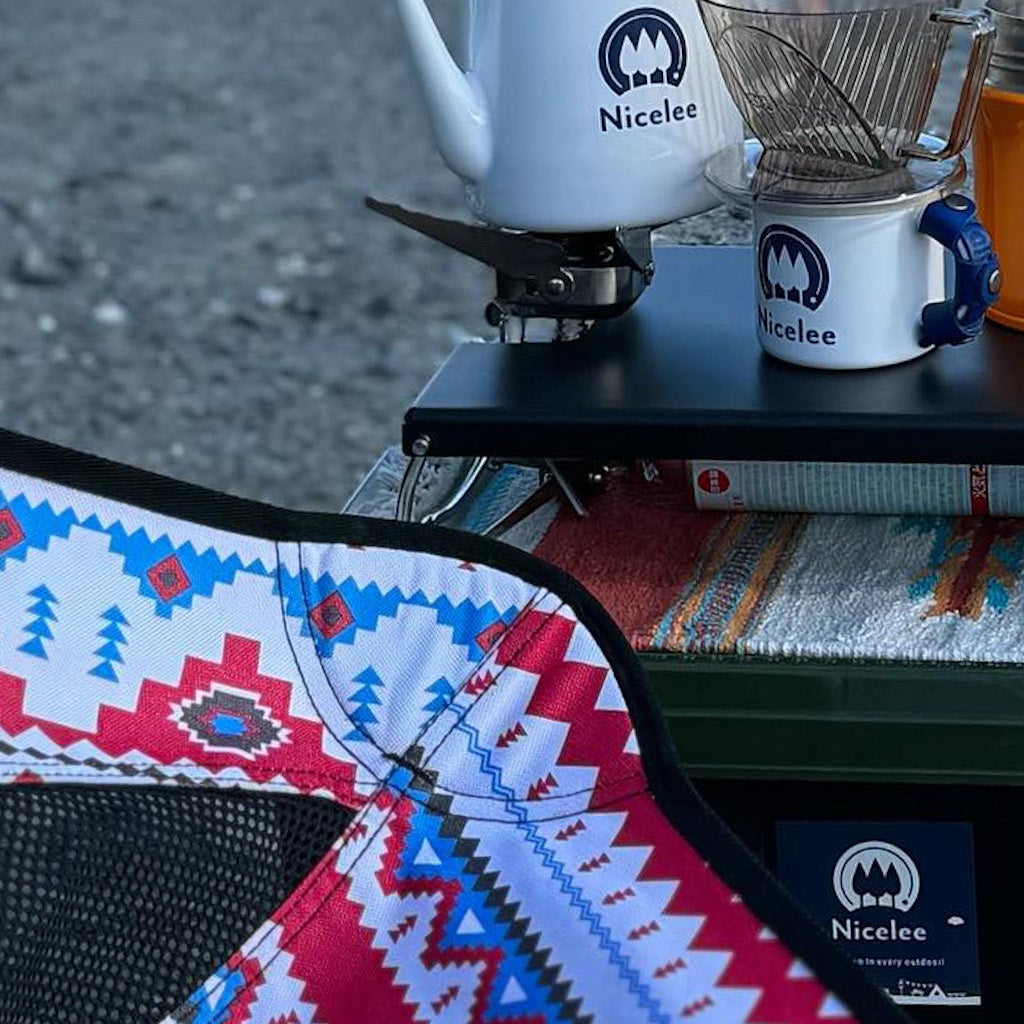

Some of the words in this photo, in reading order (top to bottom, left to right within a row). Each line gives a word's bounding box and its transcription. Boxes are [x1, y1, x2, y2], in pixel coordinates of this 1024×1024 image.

[599, 98, 698, 132] Nicelee
[757, 304, 837, 346] Nicelee
[831, 918, 927, 941] Nicelee
